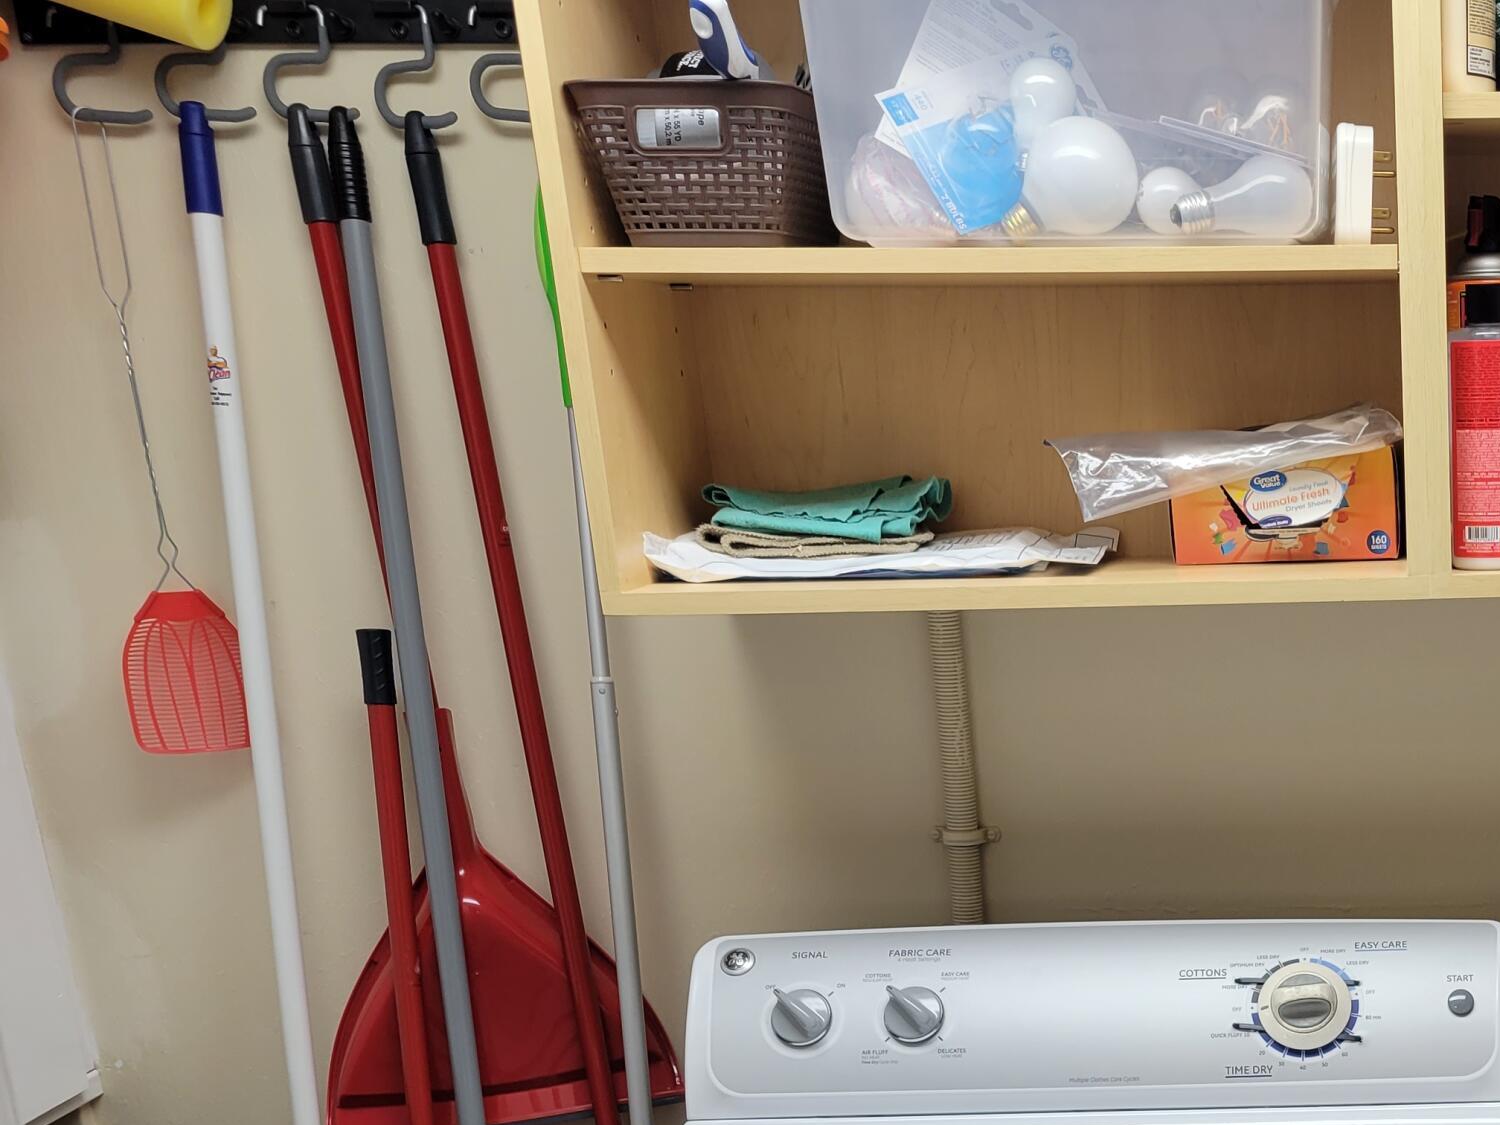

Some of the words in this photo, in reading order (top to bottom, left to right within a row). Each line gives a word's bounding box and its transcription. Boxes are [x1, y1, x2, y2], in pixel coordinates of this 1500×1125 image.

[673, 120, 681, 129] 55
[674, 130, 682, 142] YD
[1254, 474, 1280, 485] Great
[1252, 494, 1297, 511] Ultimate
[1301, 488, 1329, 501] Fresh
[1308, 499, 1332, 508] Sheets
[1371, 534, 1387, 545] 160
[1354, 941, 1378, 950] EASY
[1381, 940, 1407, 949] CARE
[791, 951, 828, 959] SIGNAL
[888, 949, 924, 957] FABRIC
[925, 948, 952, 956] CARE
[1179, 968, 1227, 977] COTTONS
[1446, 974, 1474, 982] START
[1225, 1066, 1250, 1075] TIME
[1252, 1065, 1273, 1074] DRY
